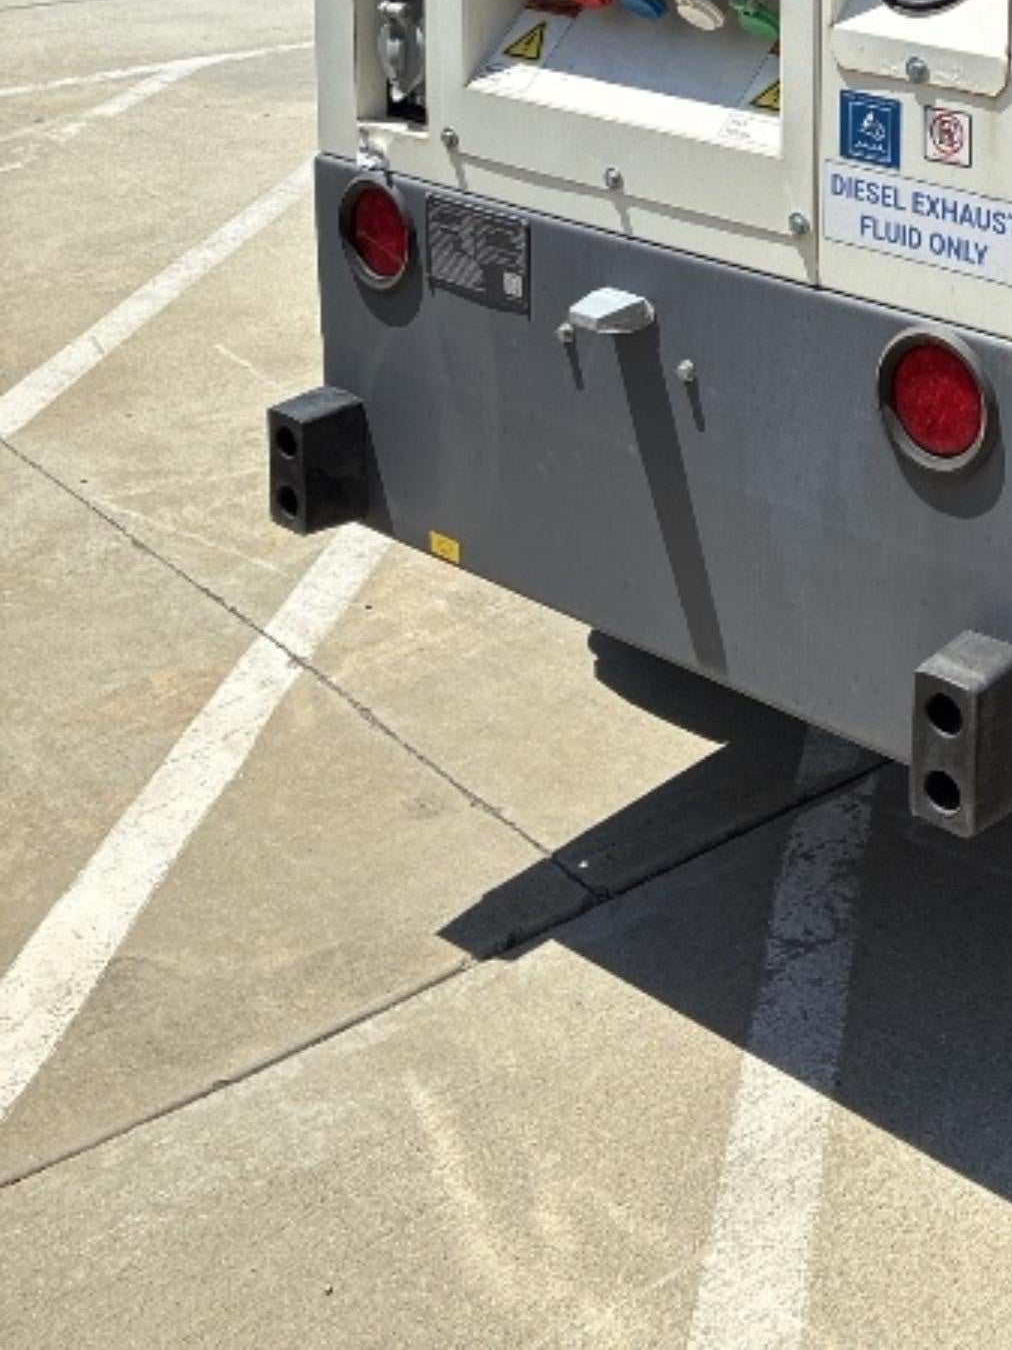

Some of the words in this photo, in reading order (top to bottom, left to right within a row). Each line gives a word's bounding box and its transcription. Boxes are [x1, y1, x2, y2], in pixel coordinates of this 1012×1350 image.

[830, 172, 907, 211] DIESEL
[859, 214, 922, 250] FLUID
[929, 233, 988, 266] ONLY
